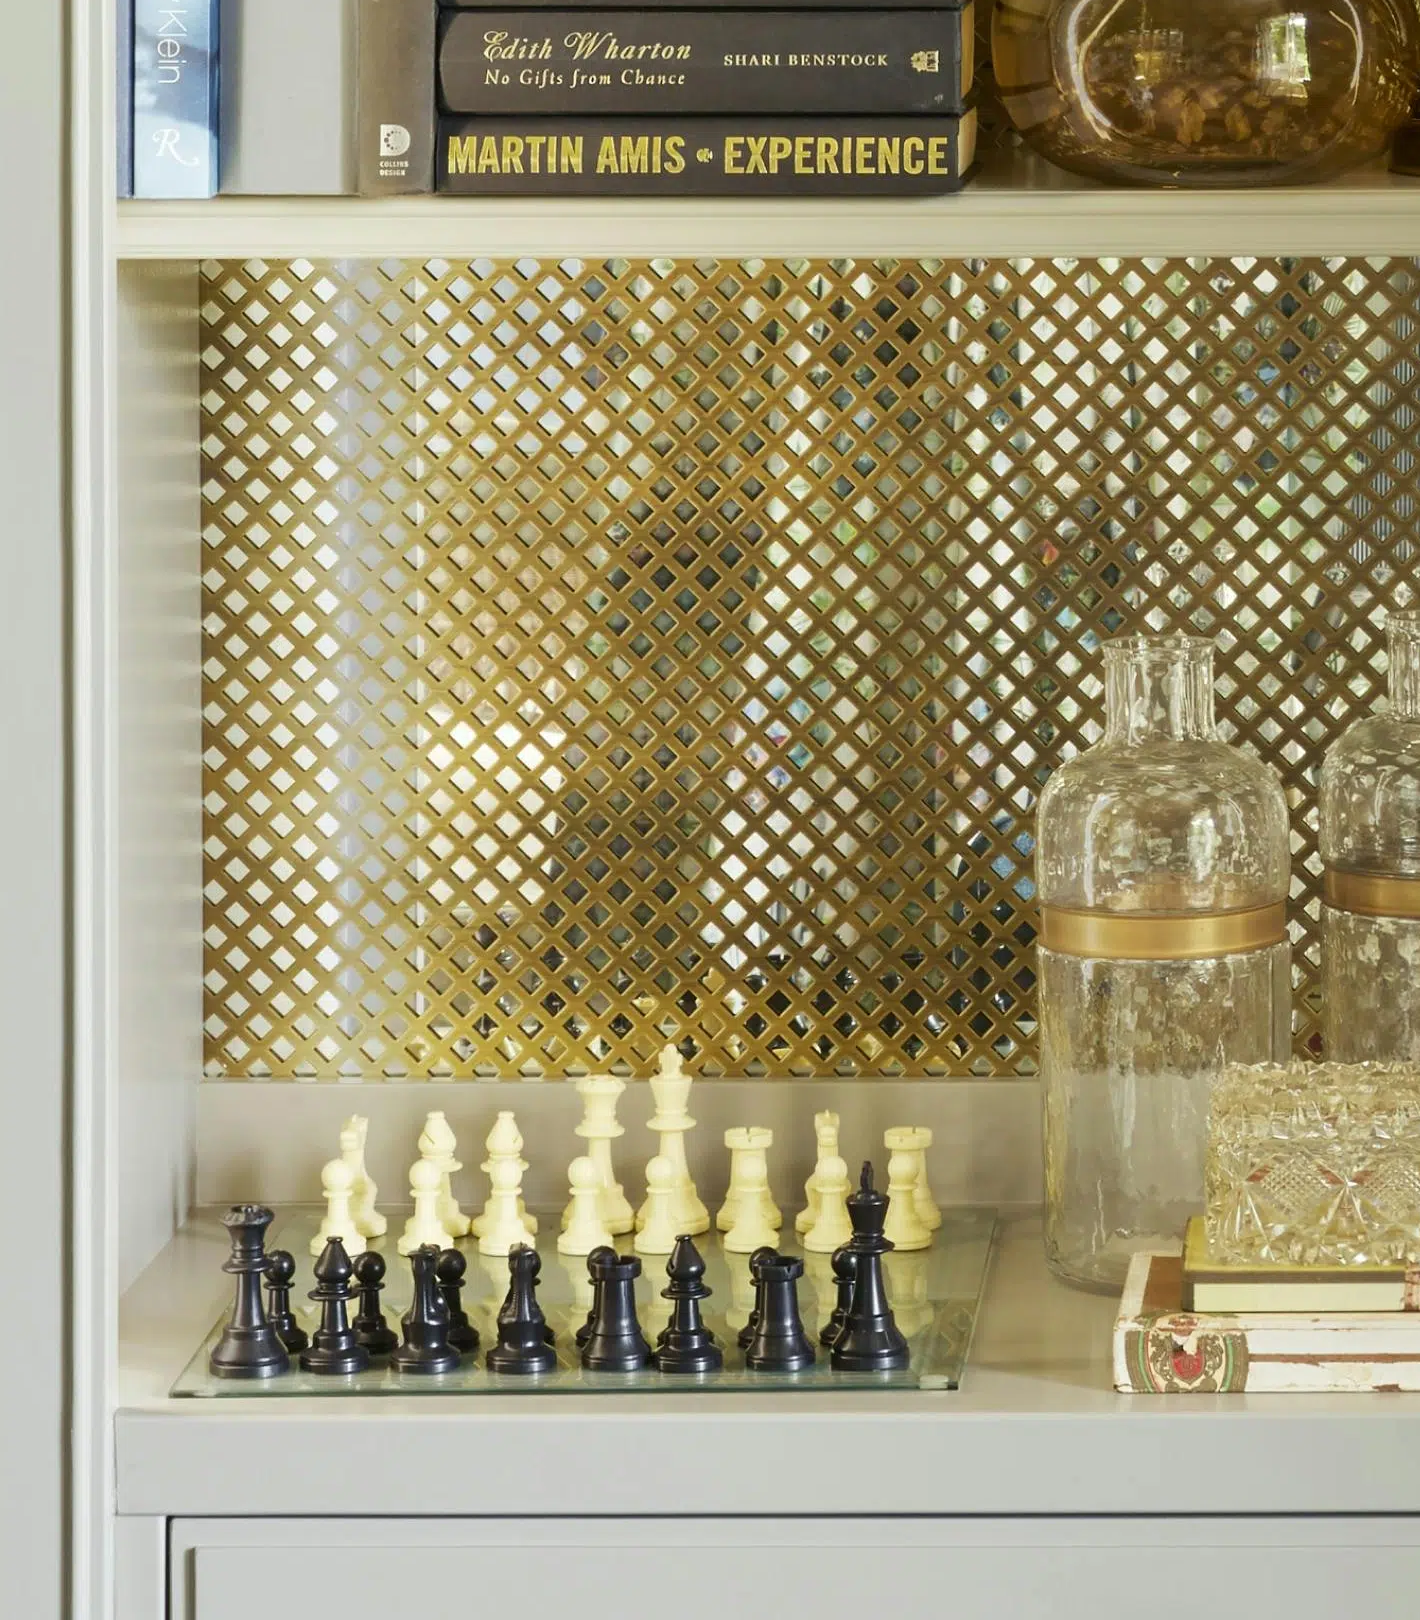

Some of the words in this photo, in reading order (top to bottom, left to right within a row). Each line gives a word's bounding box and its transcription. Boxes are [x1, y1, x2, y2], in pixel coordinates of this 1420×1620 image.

[157, 10, 188, 84] Klein
[483, 30, 553, 62] Edith
[564, 31, 692, 60] Wharton
[723, 54, 779, 66] SHARI
[788, 53, 889, 66] BENSTOCK
[484, 68, 510, 85] No
[520, 69, 563, 88] Gifts
[569, 68, 611, 88] from
[621, 69, 685, 85] Chance
[448, 135, 583, 175] MARTIN
[595, 135, 687, 175] AMIS
[724, 136, 948, 175] EXPERIENCE
